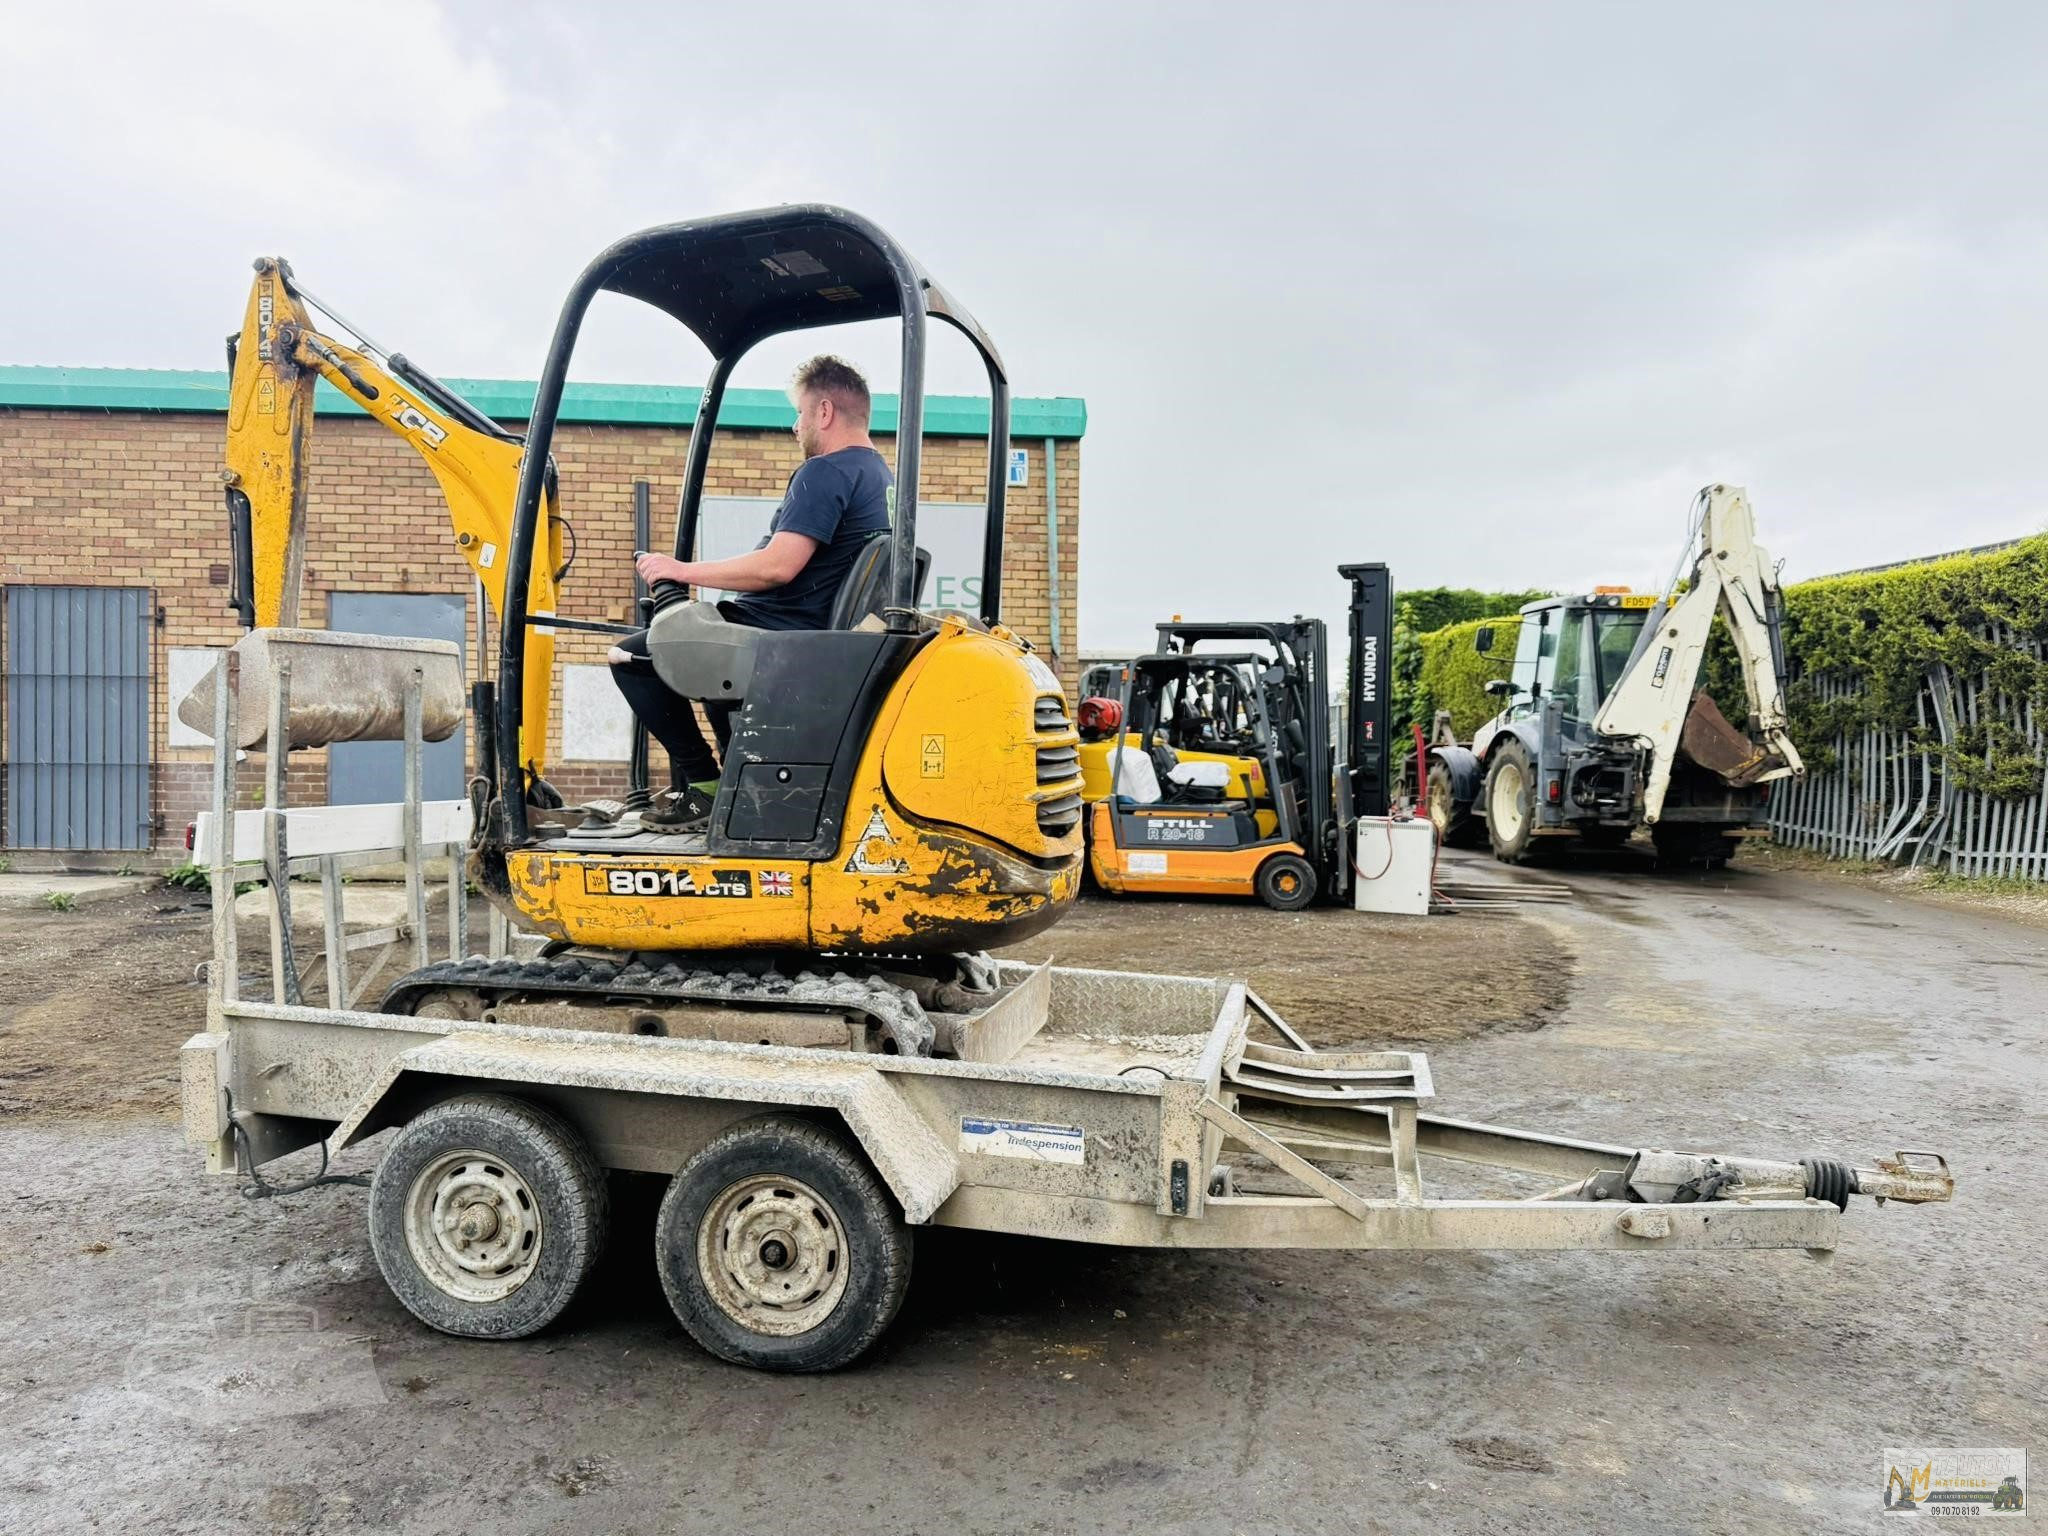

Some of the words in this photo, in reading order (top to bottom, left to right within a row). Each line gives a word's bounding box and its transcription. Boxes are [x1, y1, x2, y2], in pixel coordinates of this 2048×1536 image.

[920, 576, 983, 609] ES
[1363, 636, 1378, 702] HYUNDAI
[1147, 819, 1214, 829] STILL
[1147, 828, 1159, 840] R
